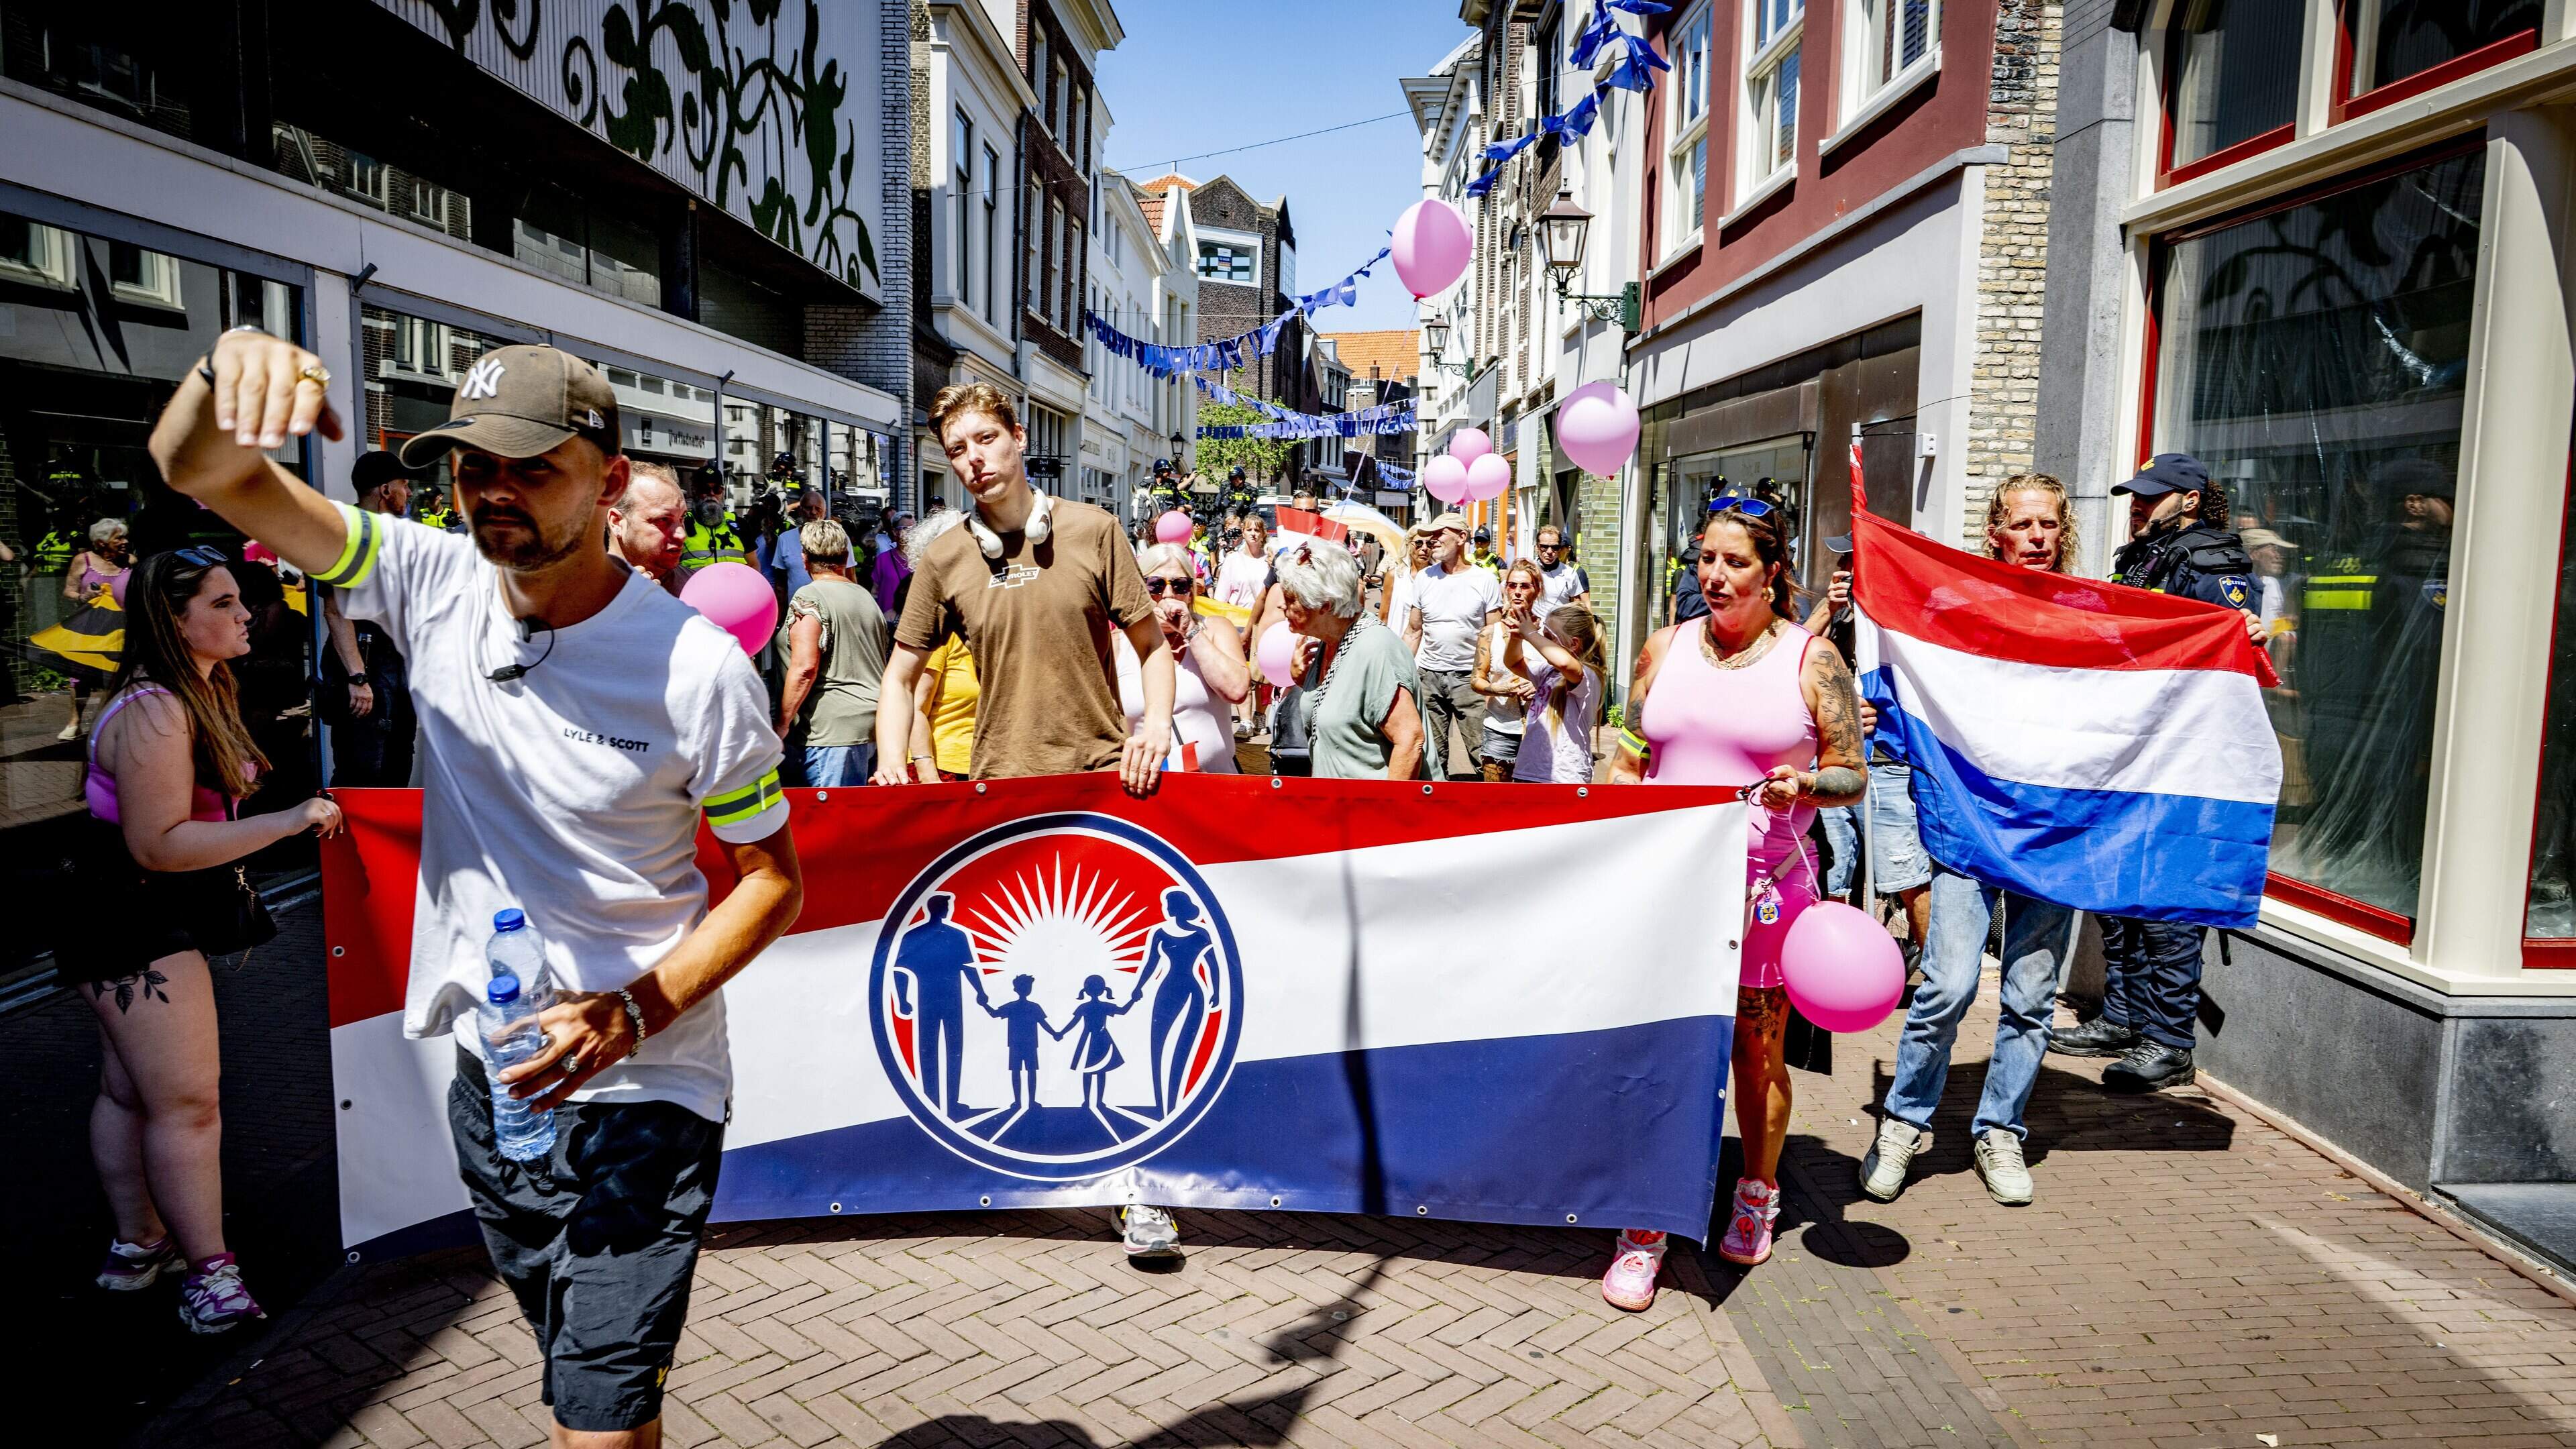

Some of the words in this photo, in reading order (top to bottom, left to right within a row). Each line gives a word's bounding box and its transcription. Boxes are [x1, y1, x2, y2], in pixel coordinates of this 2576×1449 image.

[991, 571, 1037, 584] CHEVROLET
[564, 728, 593, 743] LYLE
[596, 734, 604, 745] &
[609, 737, 649, 752] SCOTT
